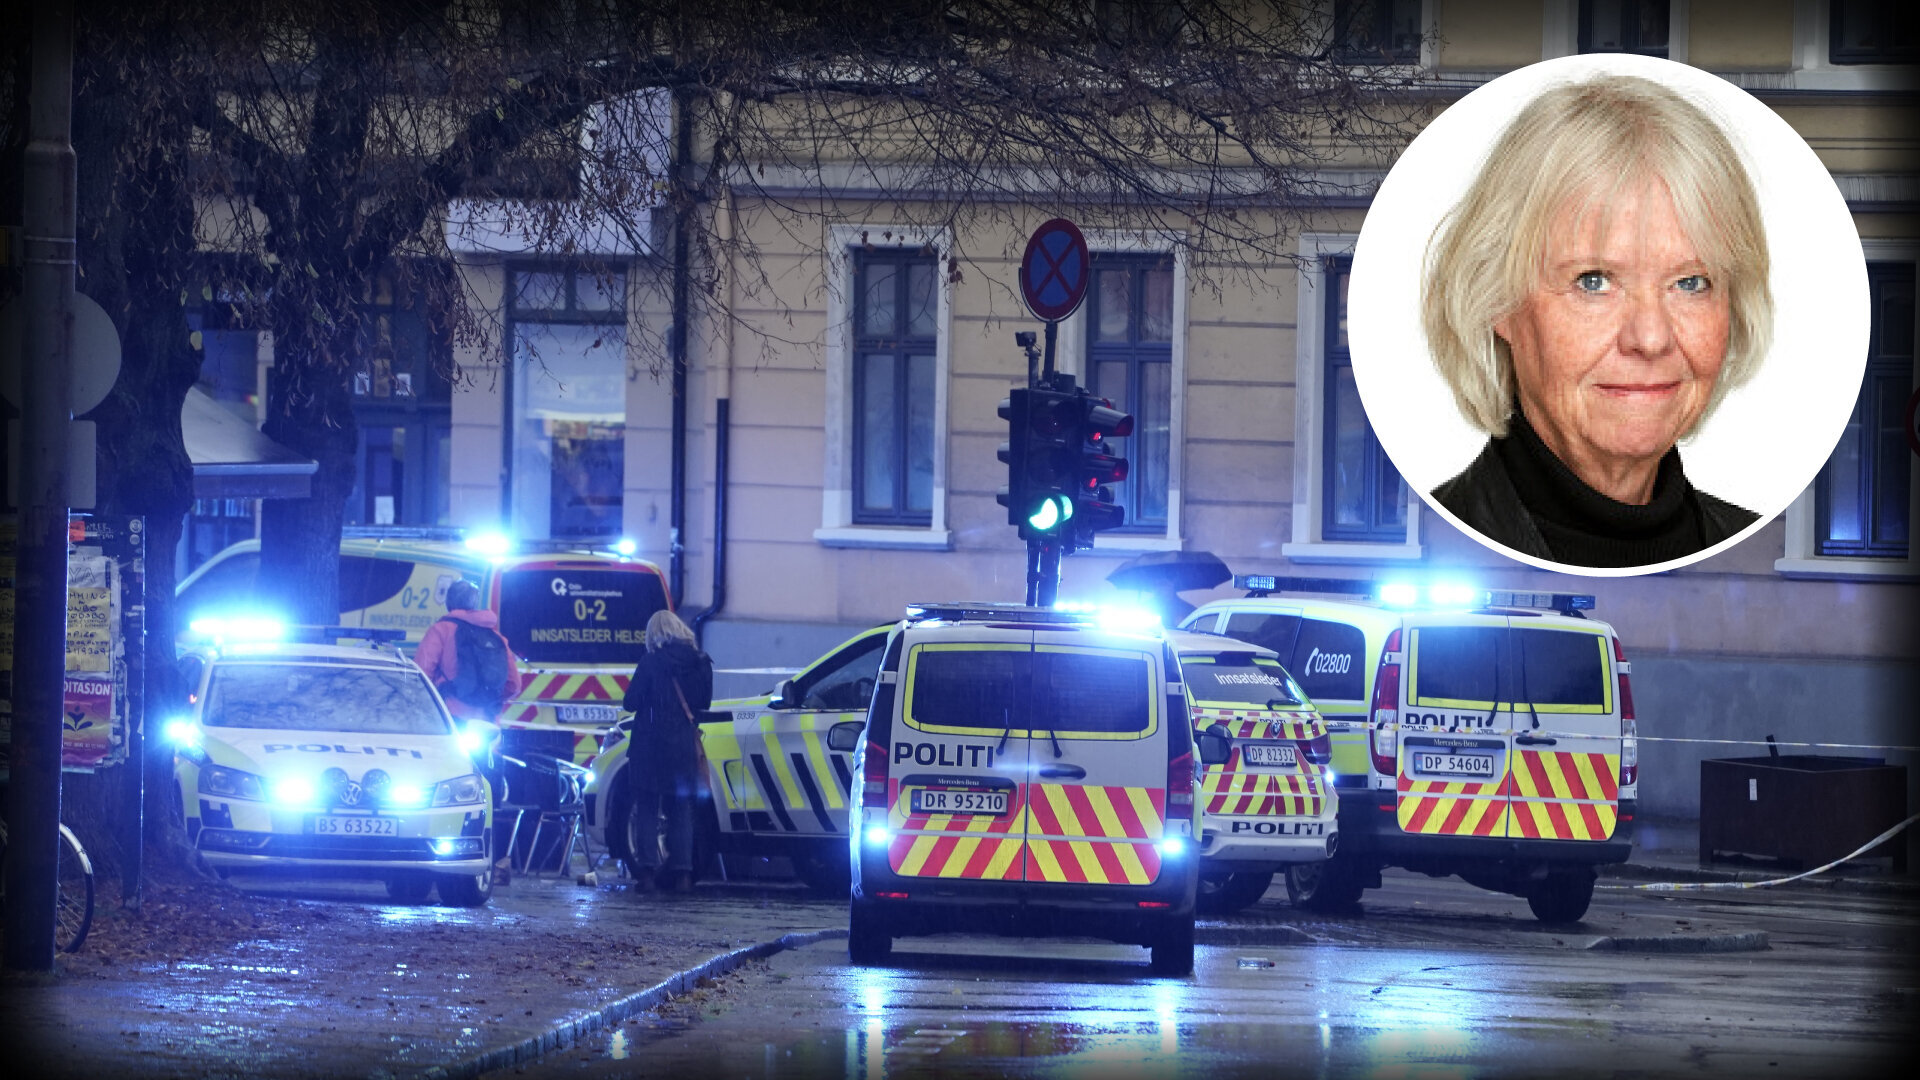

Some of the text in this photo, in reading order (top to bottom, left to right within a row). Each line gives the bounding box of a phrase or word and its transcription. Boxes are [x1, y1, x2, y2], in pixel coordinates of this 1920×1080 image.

[402, 587, 430, 609] 0-2
[574, 599, 607, 621] 0-2
[531, 628, 612, 642] INNSATSLEDER
[1314, 653, 1352, 674] 02800
[1214, 672, 1283, 687] Innsatsleder
[263, 744, 423, 760] POLITI
[894, 742, 994, 768] POLITI
[1251, 747, 1295, 762] DP 82332
[1425, 756, 1490, 772] DP 54604
[925, 793, 1003, 810] DR 95210
[319, 818, 392, 834] BS 63522
[1231, 821, 1324, 836] POLITI
